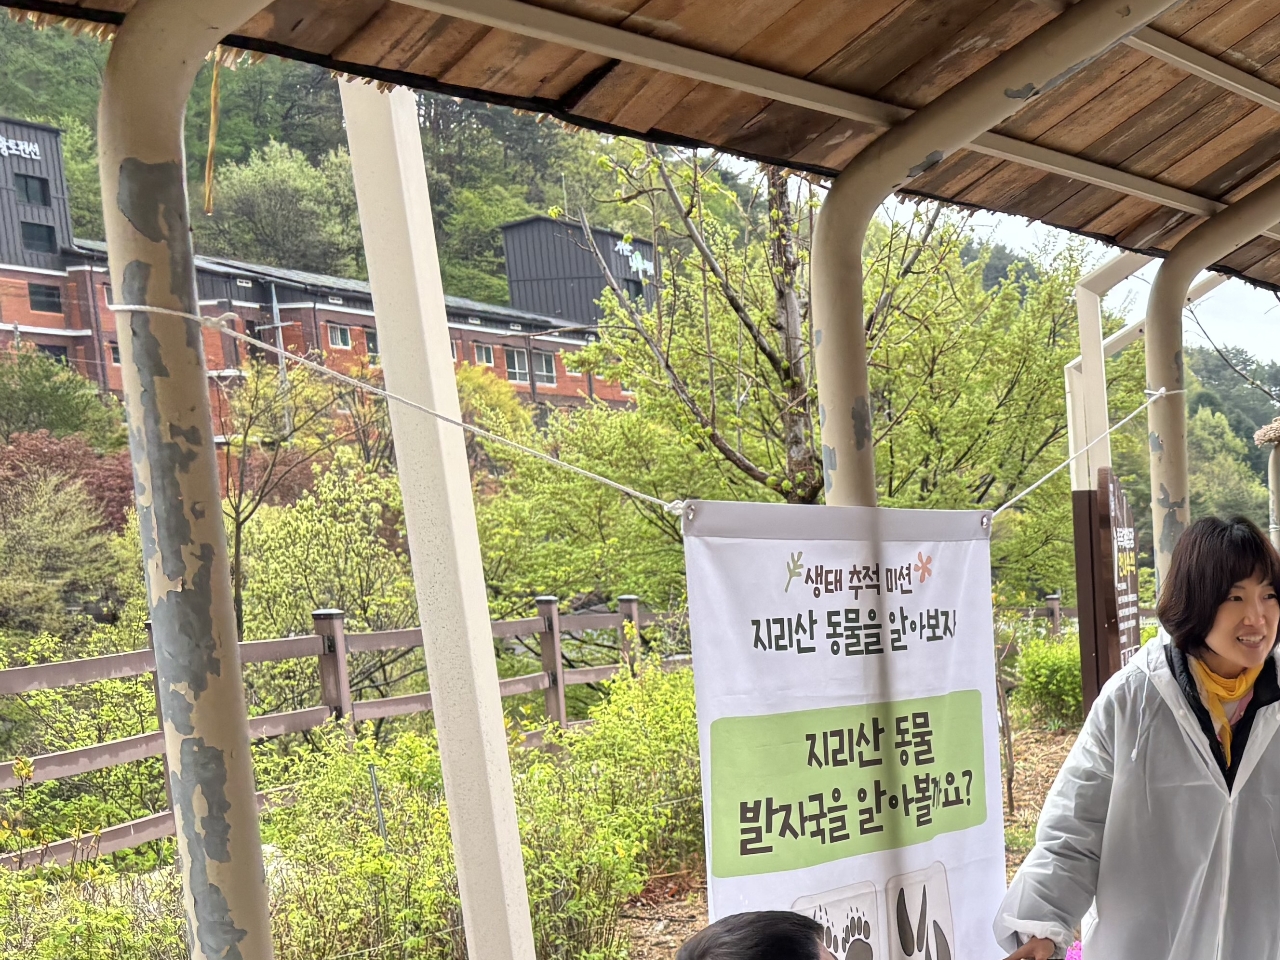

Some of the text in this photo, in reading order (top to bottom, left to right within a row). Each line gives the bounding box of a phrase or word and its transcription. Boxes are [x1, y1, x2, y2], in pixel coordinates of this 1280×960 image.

[804, 562, 913, 601] 생태 추적 미션
[751, 606, 957, 657] 지리산 동물을 알아보자
[805, 711, 935, 769] 지리산 동물
[739, 769, 974, 857] 발자국을 알아볼까요?
